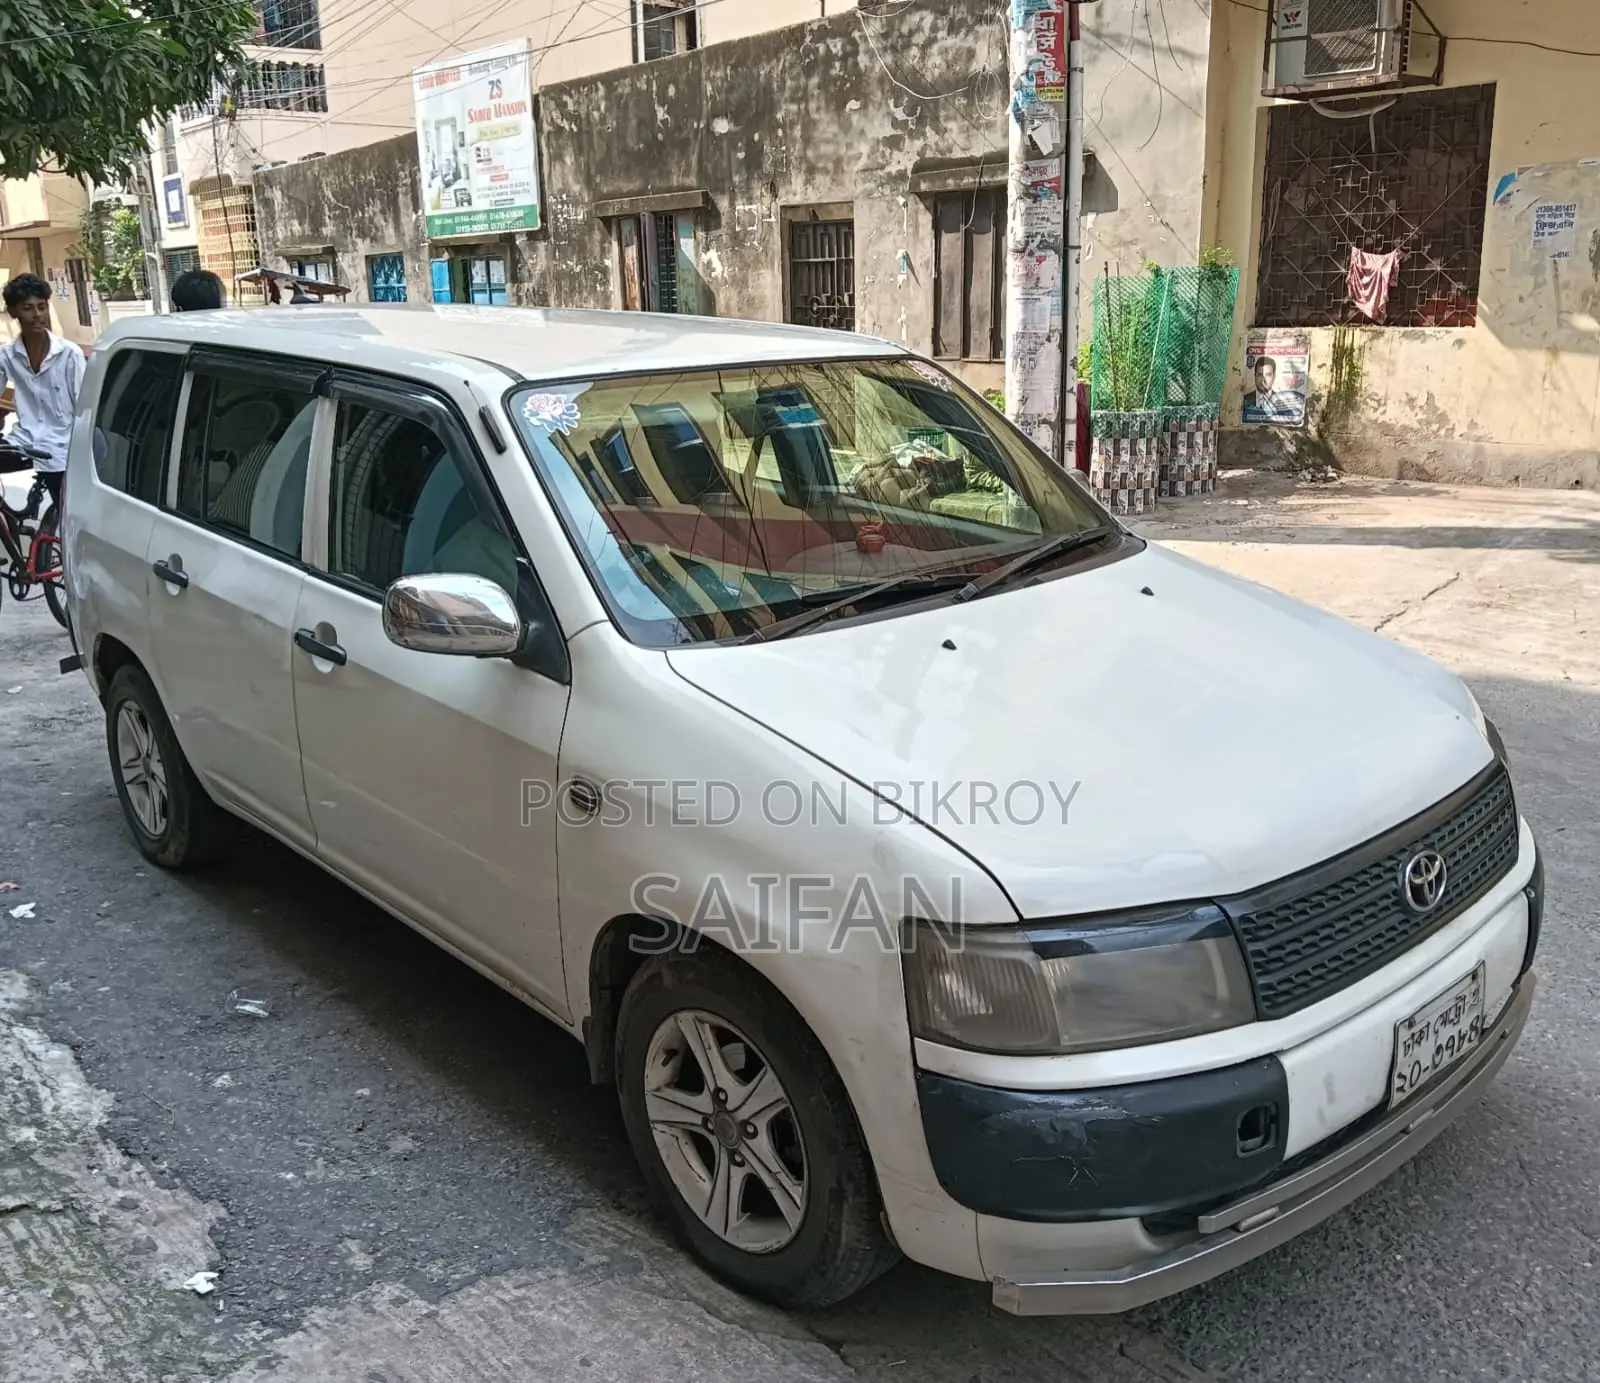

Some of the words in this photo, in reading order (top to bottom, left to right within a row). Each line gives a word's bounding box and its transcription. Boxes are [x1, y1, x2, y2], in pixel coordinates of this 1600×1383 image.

[488, 78, 503, 100] ZS
[493, 100, 527, 119] MANSION
[1403, 1021, 1431, 1058] ঢাকা
